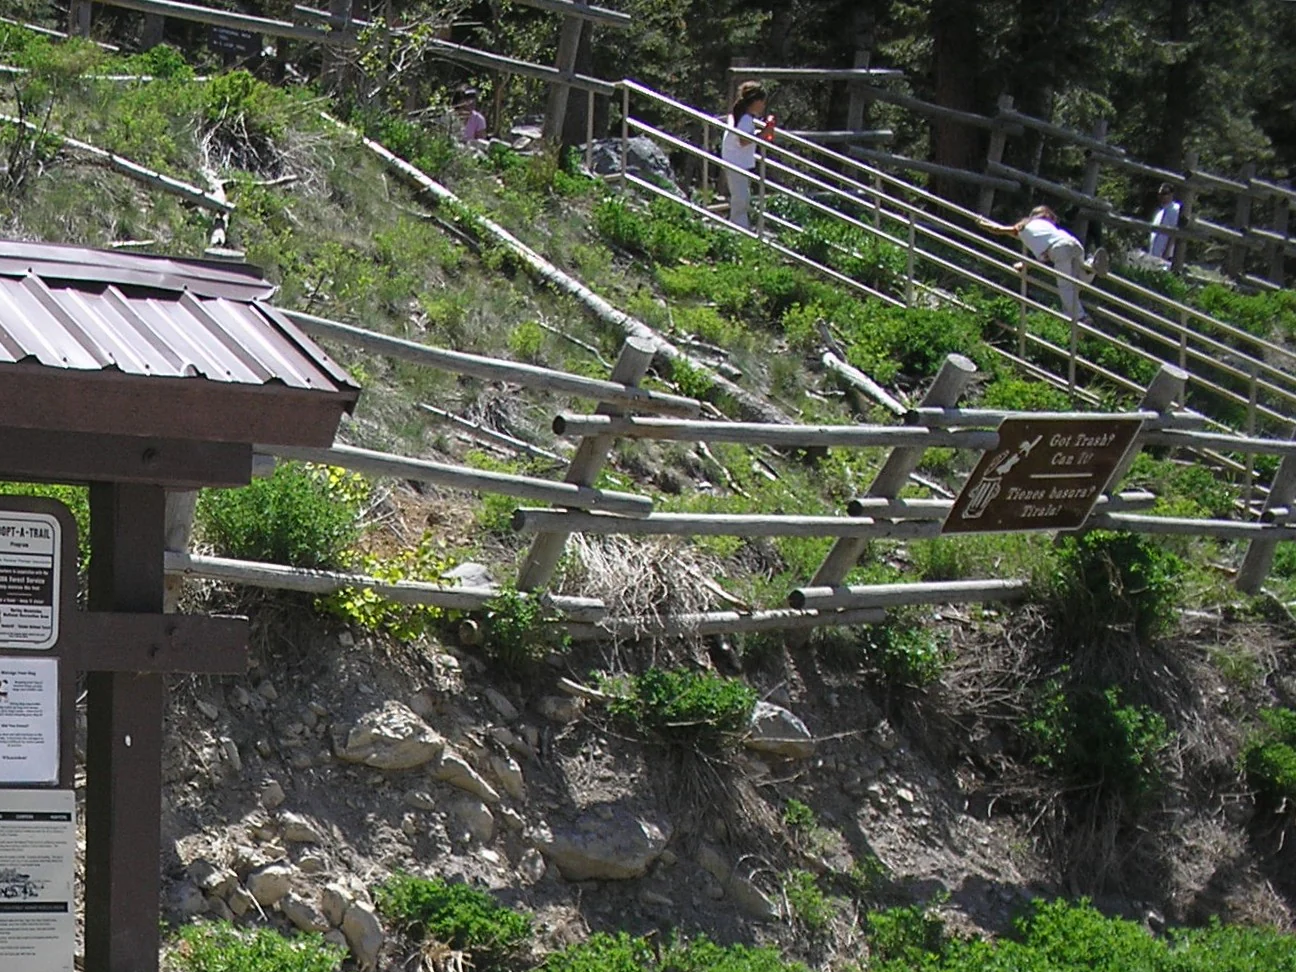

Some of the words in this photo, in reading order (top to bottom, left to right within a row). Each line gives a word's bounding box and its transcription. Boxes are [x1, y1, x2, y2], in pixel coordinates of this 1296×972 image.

[1050, 433, 1071, 447] Got
[1074, 432, 1116, 447] Trash?
[1051, 452, 1074, 465] Can
[1006, 487, 1046, 500] Tienes
[1048, 485, 1097, 499] basura?
